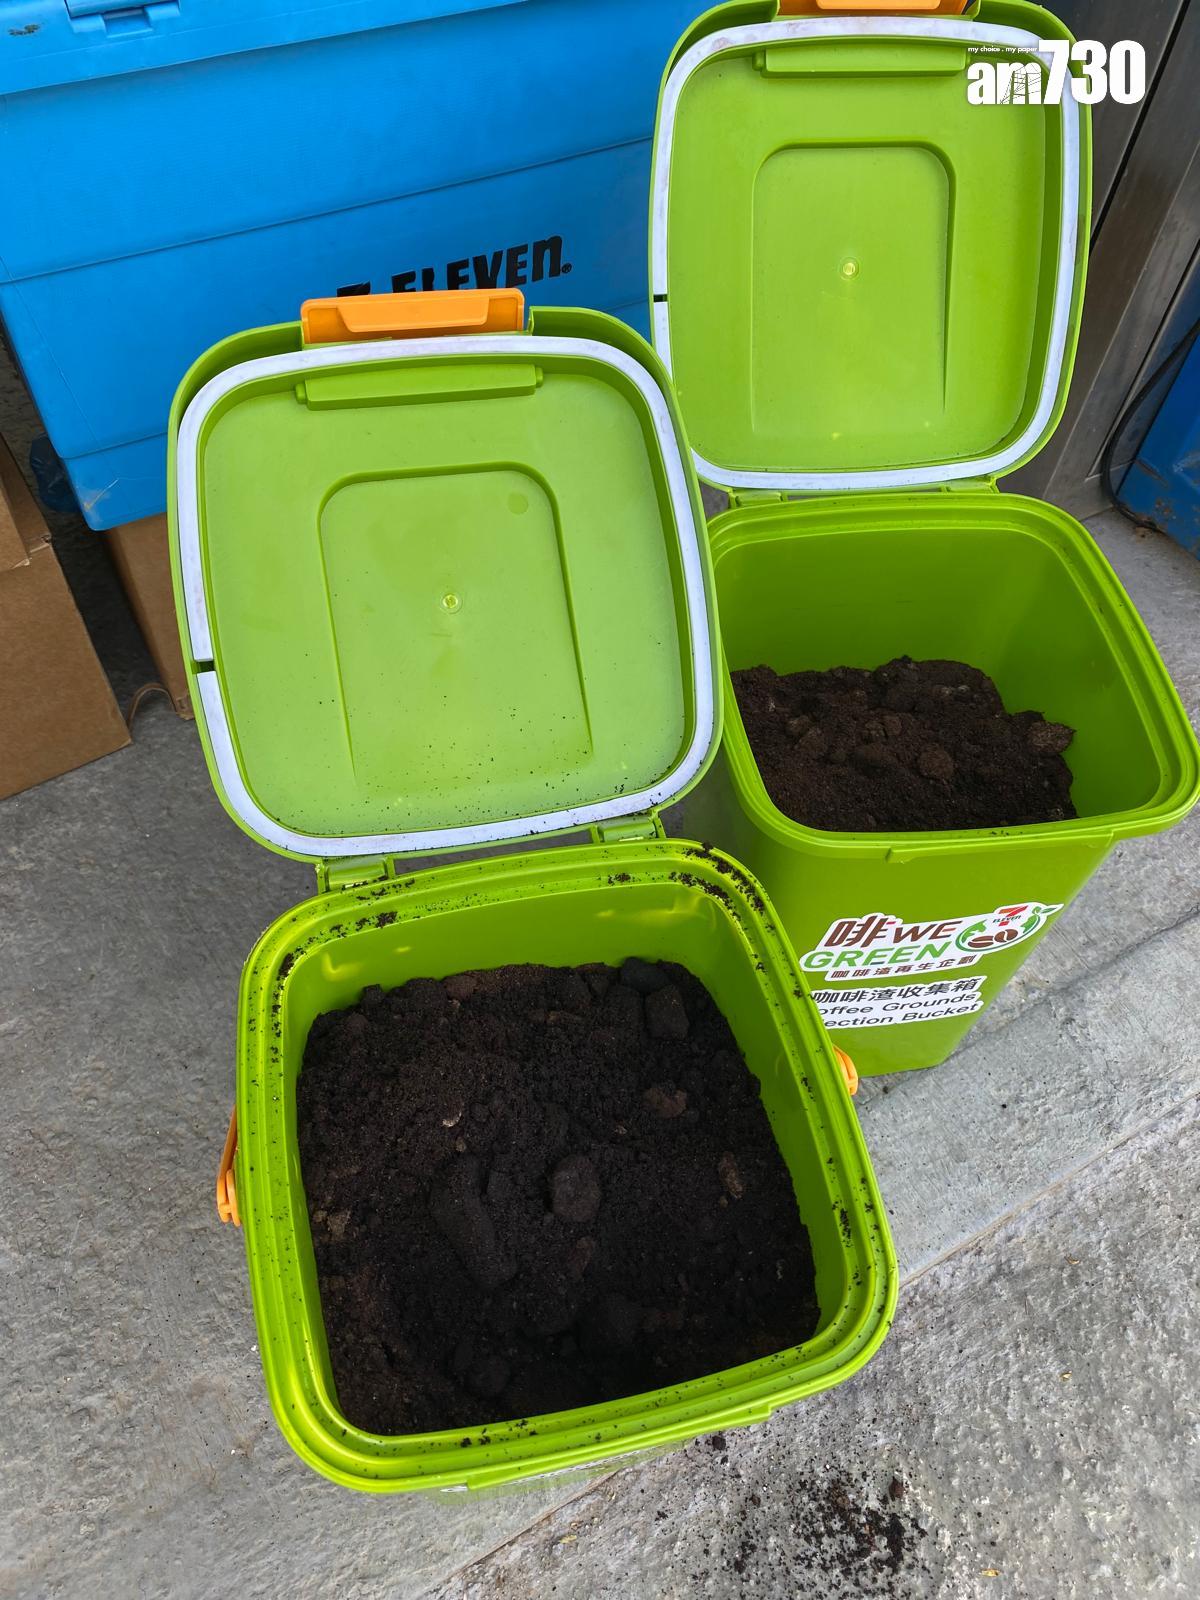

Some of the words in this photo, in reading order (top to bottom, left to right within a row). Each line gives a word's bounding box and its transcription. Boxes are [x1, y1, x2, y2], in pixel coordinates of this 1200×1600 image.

[803, 941, 952, 968] GREEN
[819, 1005, 874, 1015] offee
[882, 993, 977, 1012] Grounds
[823, 1016, 894, 1027] ection
[902, 1003, 978, 1021] Bucket
